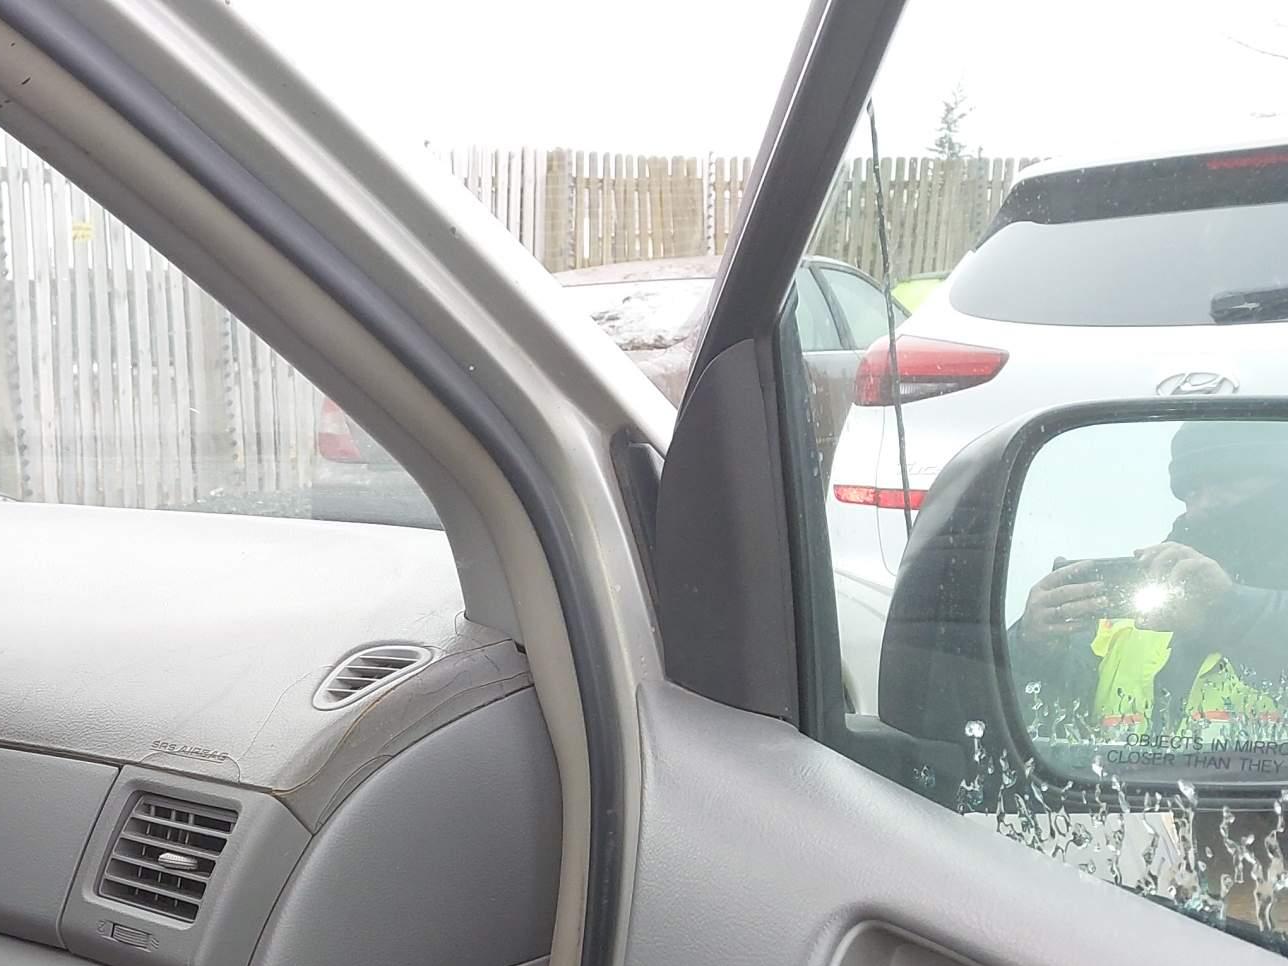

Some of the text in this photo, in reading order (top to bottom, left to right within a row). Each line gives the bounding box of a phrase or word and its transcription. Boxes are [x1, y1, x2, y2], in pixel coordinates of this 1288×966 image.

[152, 740, 229, 761] SRS AIRBAG
[1126, 733, 1203, 750] OBJECTS
[1211, 738, 1227, 752] IN
[1107, 749, 1283, 773] CLOSER THAN THEY
